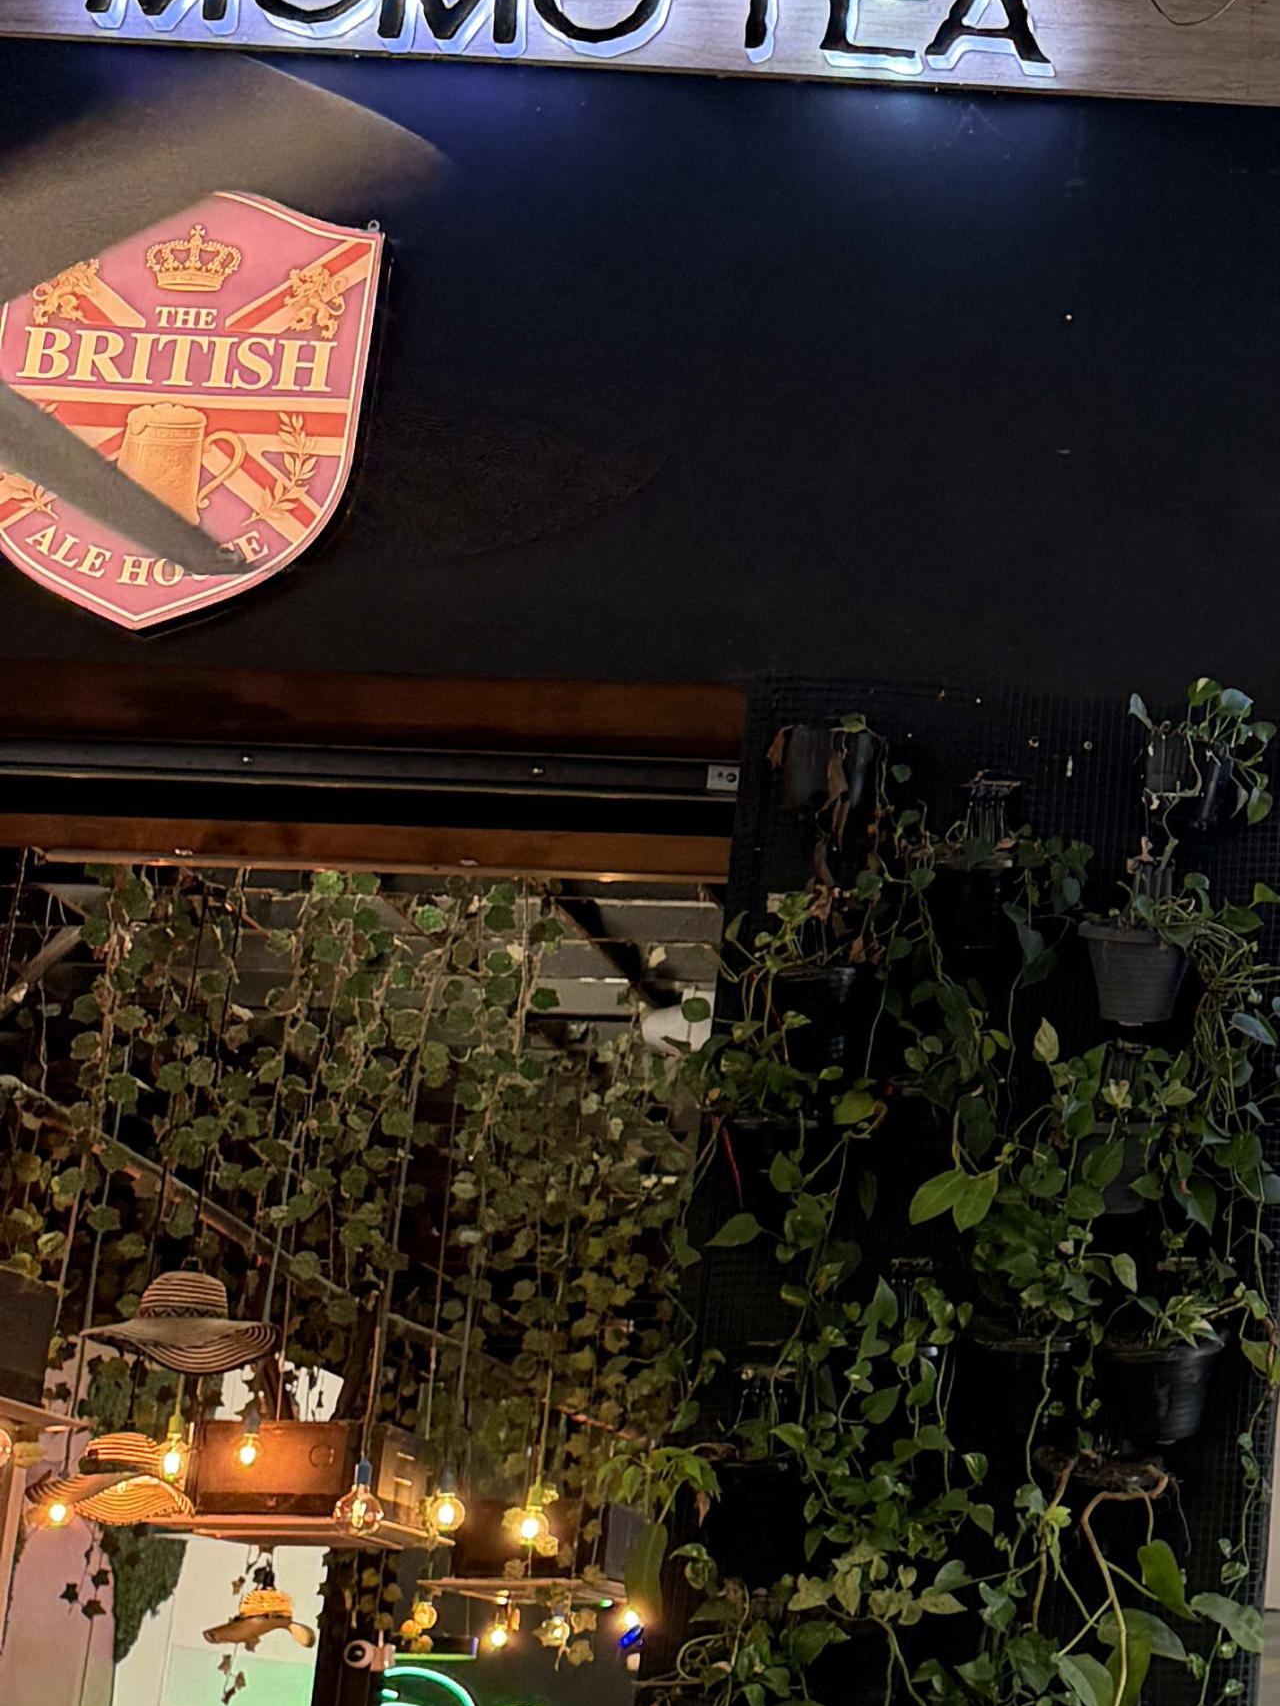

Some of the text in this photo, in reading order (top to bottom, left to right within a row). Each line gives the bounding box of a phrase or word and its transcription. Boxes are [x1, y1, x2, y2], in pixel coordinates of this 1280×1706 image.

[155, 306, 218, 330] THE
[16, 325, 338, 392] BRITISH
[26, 524, 270, 586] ALE HOE
